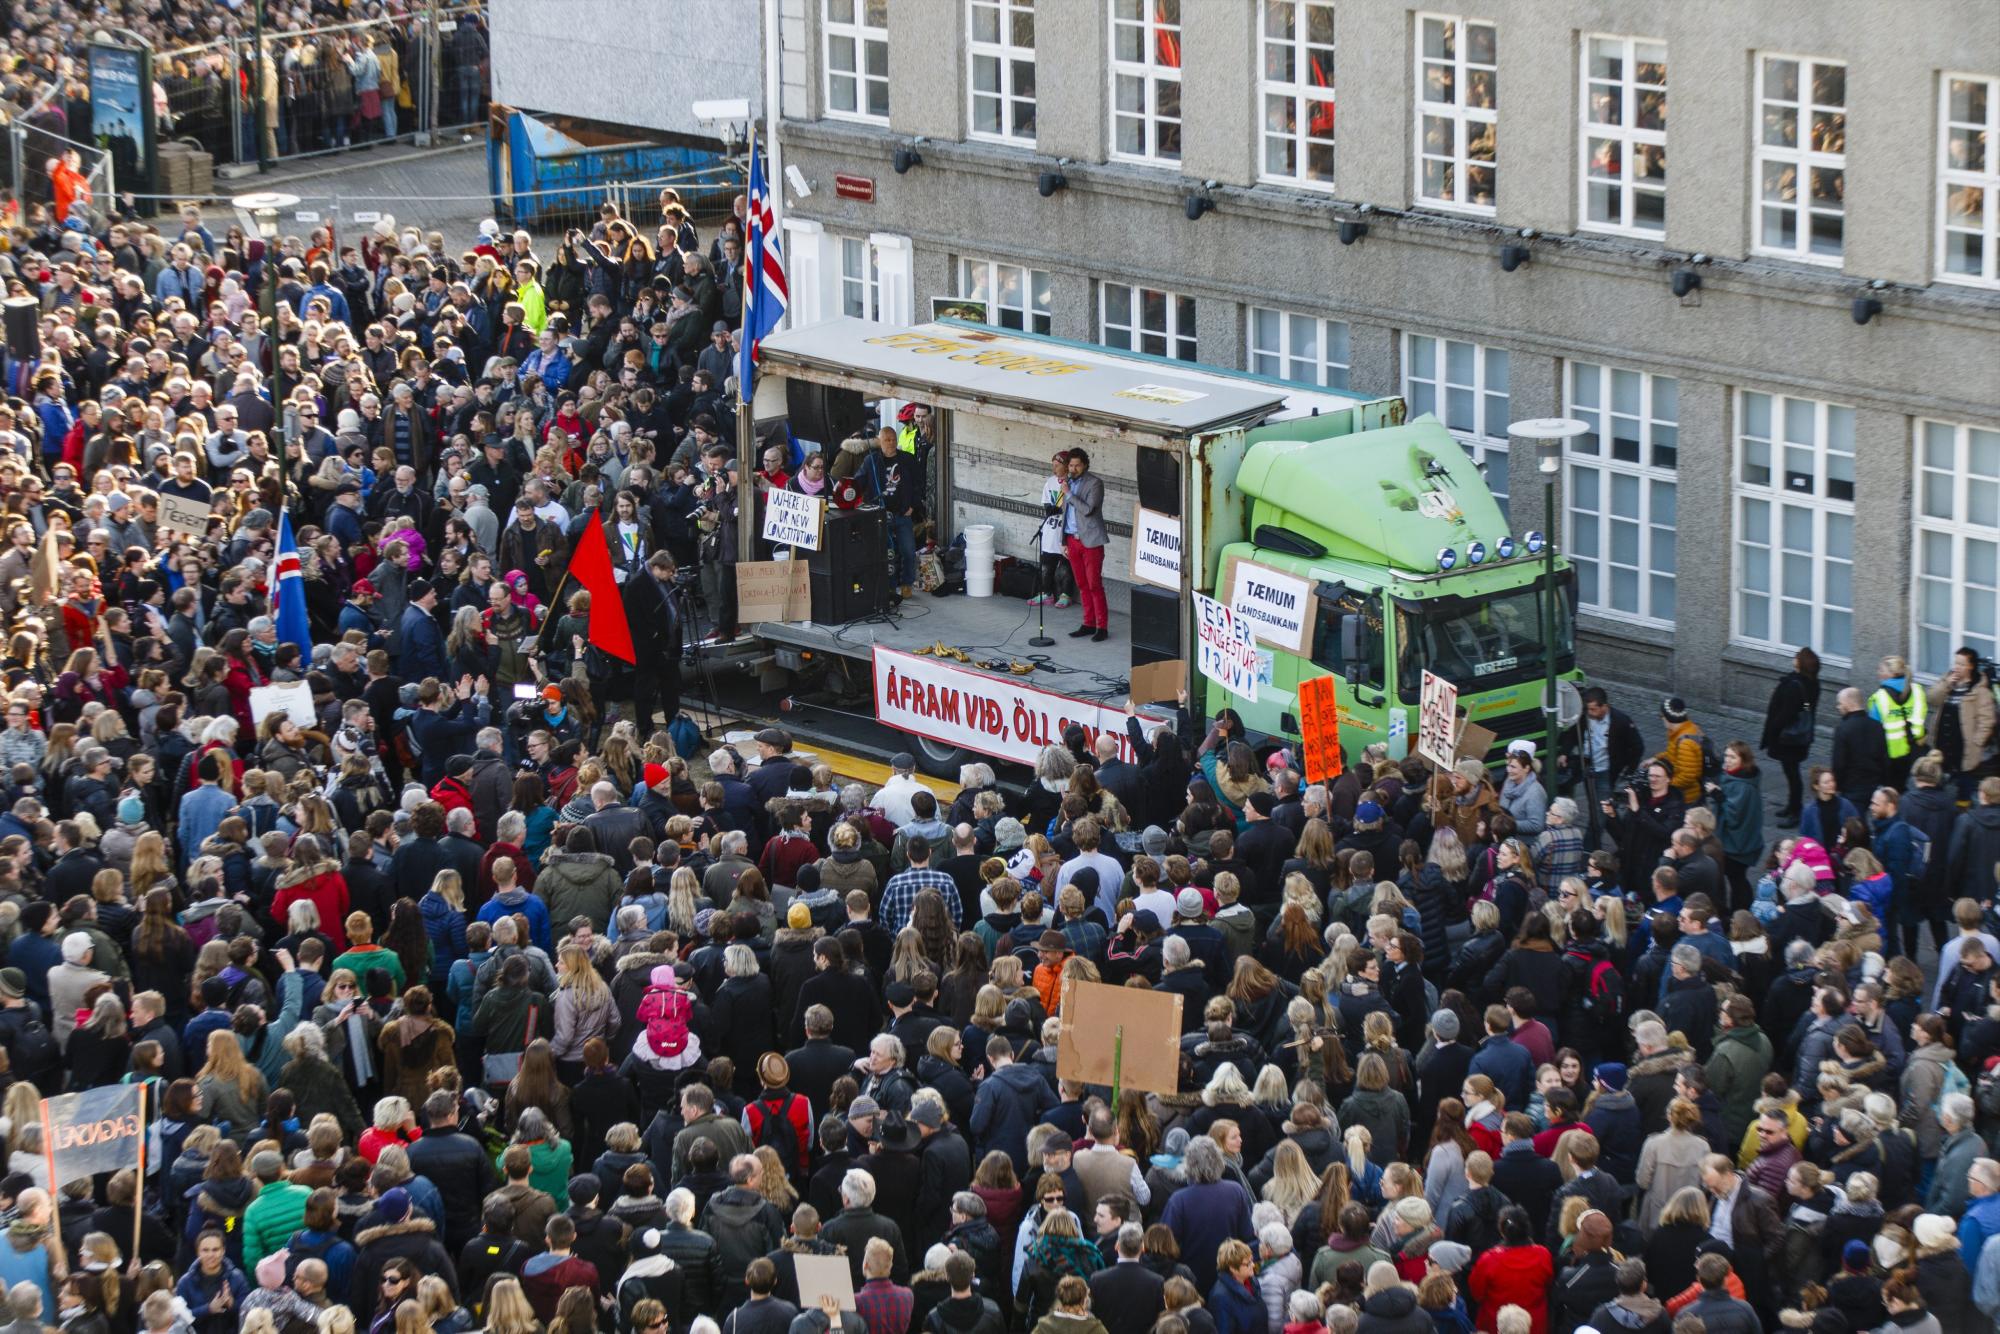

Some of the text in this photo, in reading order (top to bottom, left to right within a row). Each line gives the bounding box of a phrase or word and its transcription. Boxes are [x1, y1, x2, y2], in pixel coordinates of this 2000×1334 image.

[772, 490, 811, 513] WHERE IS
[766, 520, 818, 547] CONSTITUTION?
[791, 513, 810, 529] NEW
[1246, 580, 1296, 611] TÆMUM
[1236, 603, 1299, 633] LANDSBANKANN
[886, 665, 960, 726] ÁFRAM
[962, 692, 1009, 743] VIÐ,
[1013, 697, 1054, 746] ÖLL
[1423, 673, 1457, 718] PLANT
[1421, 701, 1450, 737] MORE
[1420, 724, 1454, 766] FOREST
